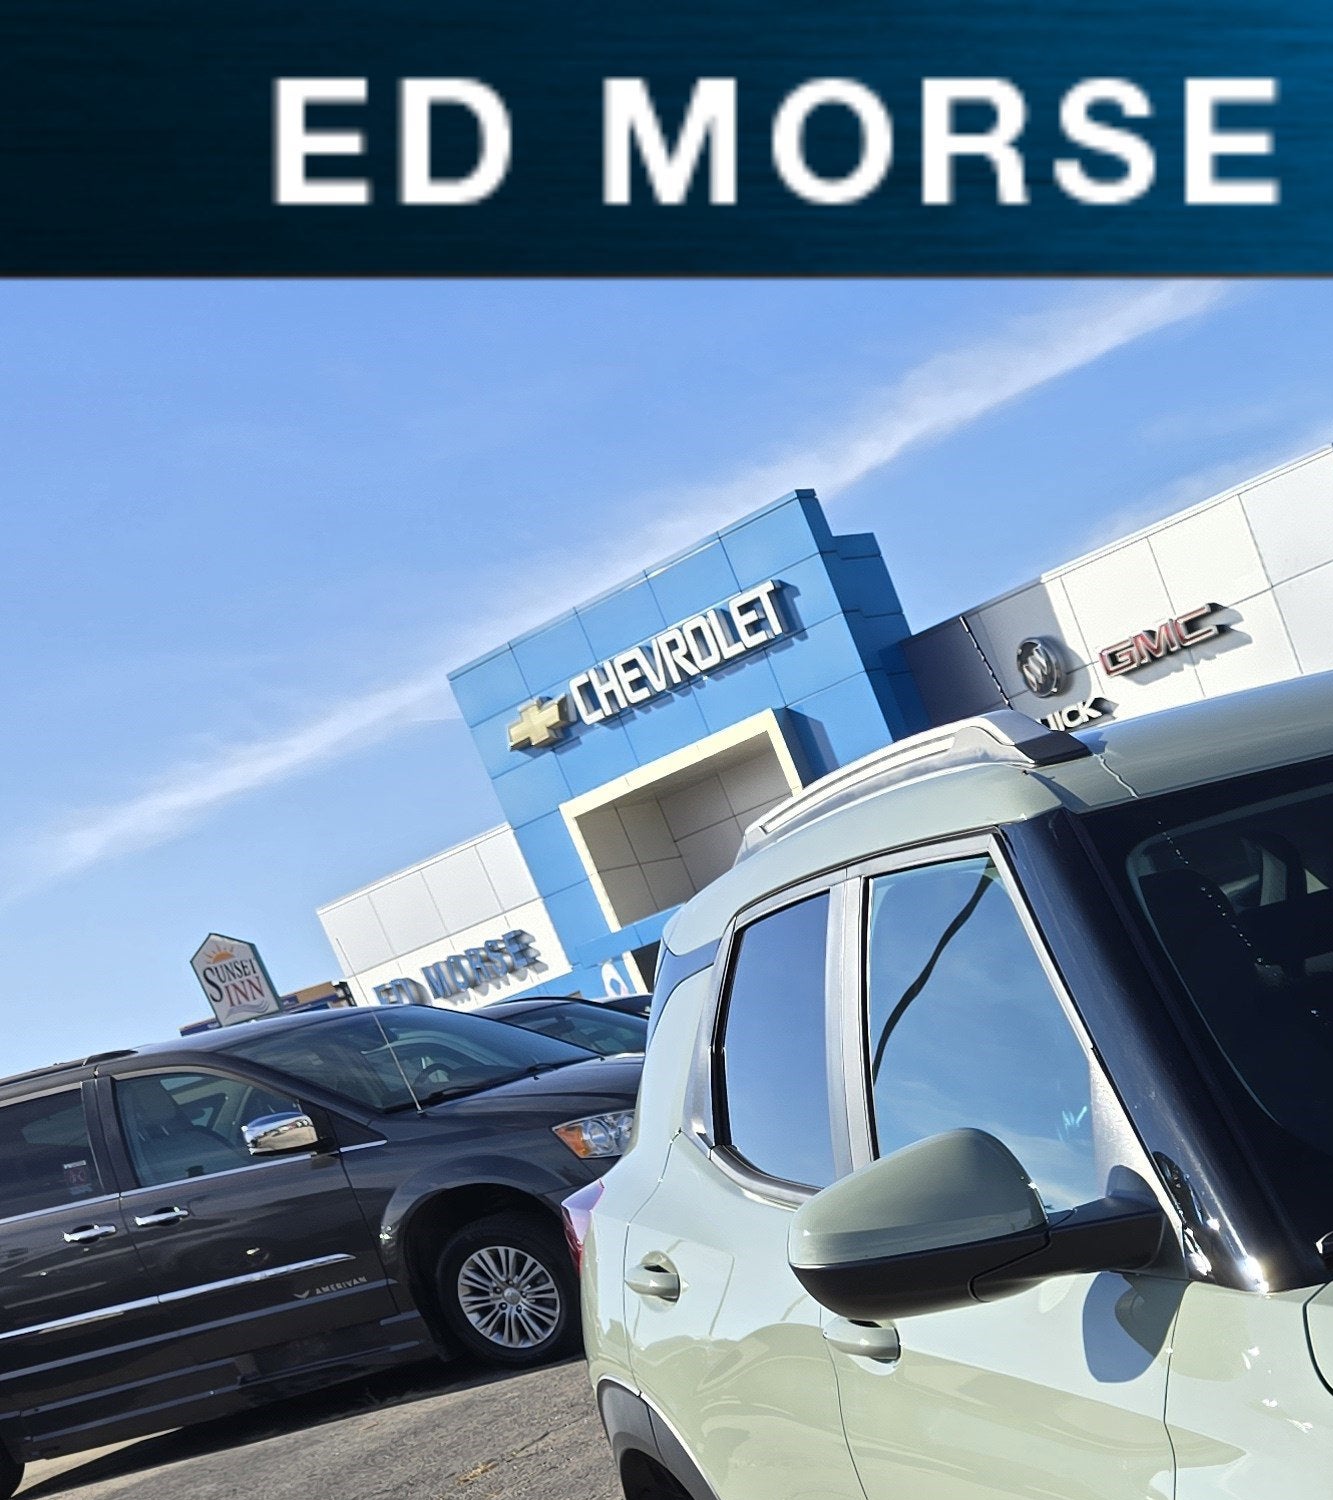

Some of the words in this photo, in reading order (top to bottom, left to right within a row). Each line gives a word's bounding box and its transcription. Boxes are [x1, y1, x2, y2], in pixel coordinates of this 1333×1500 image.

[568, 579, 783, 726] CHEVROLET
[1099, 603, 1219, 677] GMC
[202, 958, 257, 1003] SUNSET
[224, 975, 266, 1008] INN
[421, 930, 530, 999] MORSE
